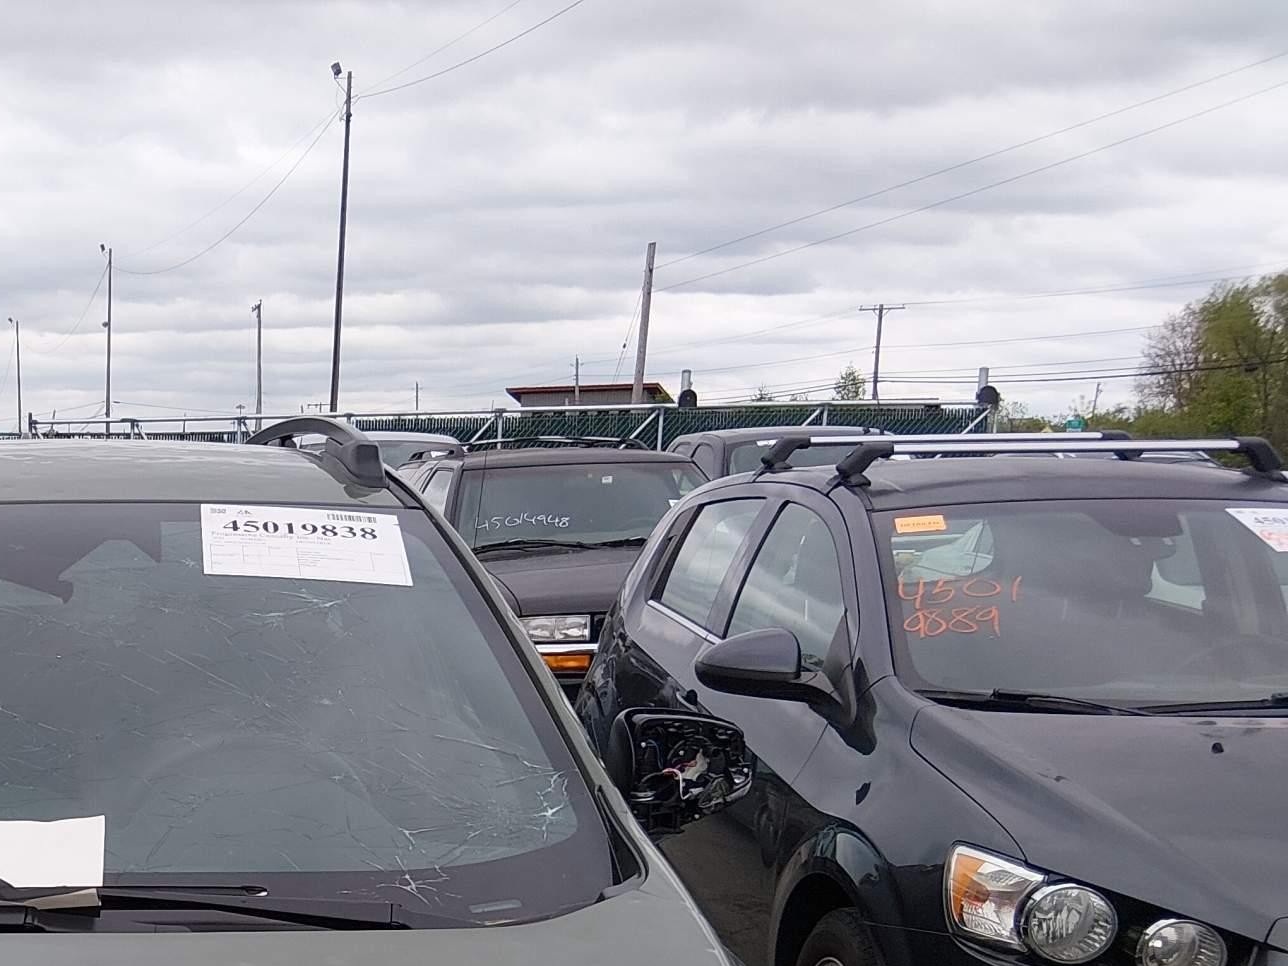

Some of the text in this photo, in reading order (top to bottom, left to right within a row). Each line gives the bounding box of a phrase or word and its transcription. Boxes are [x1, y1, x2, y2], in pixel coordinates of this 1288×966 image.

[222, 519, 379, 541] 45019838
[474, 511, 570, 531] 45014948
[898, 575, 1022, 610] 4501
[903, 605, 1001, 638] 9889
